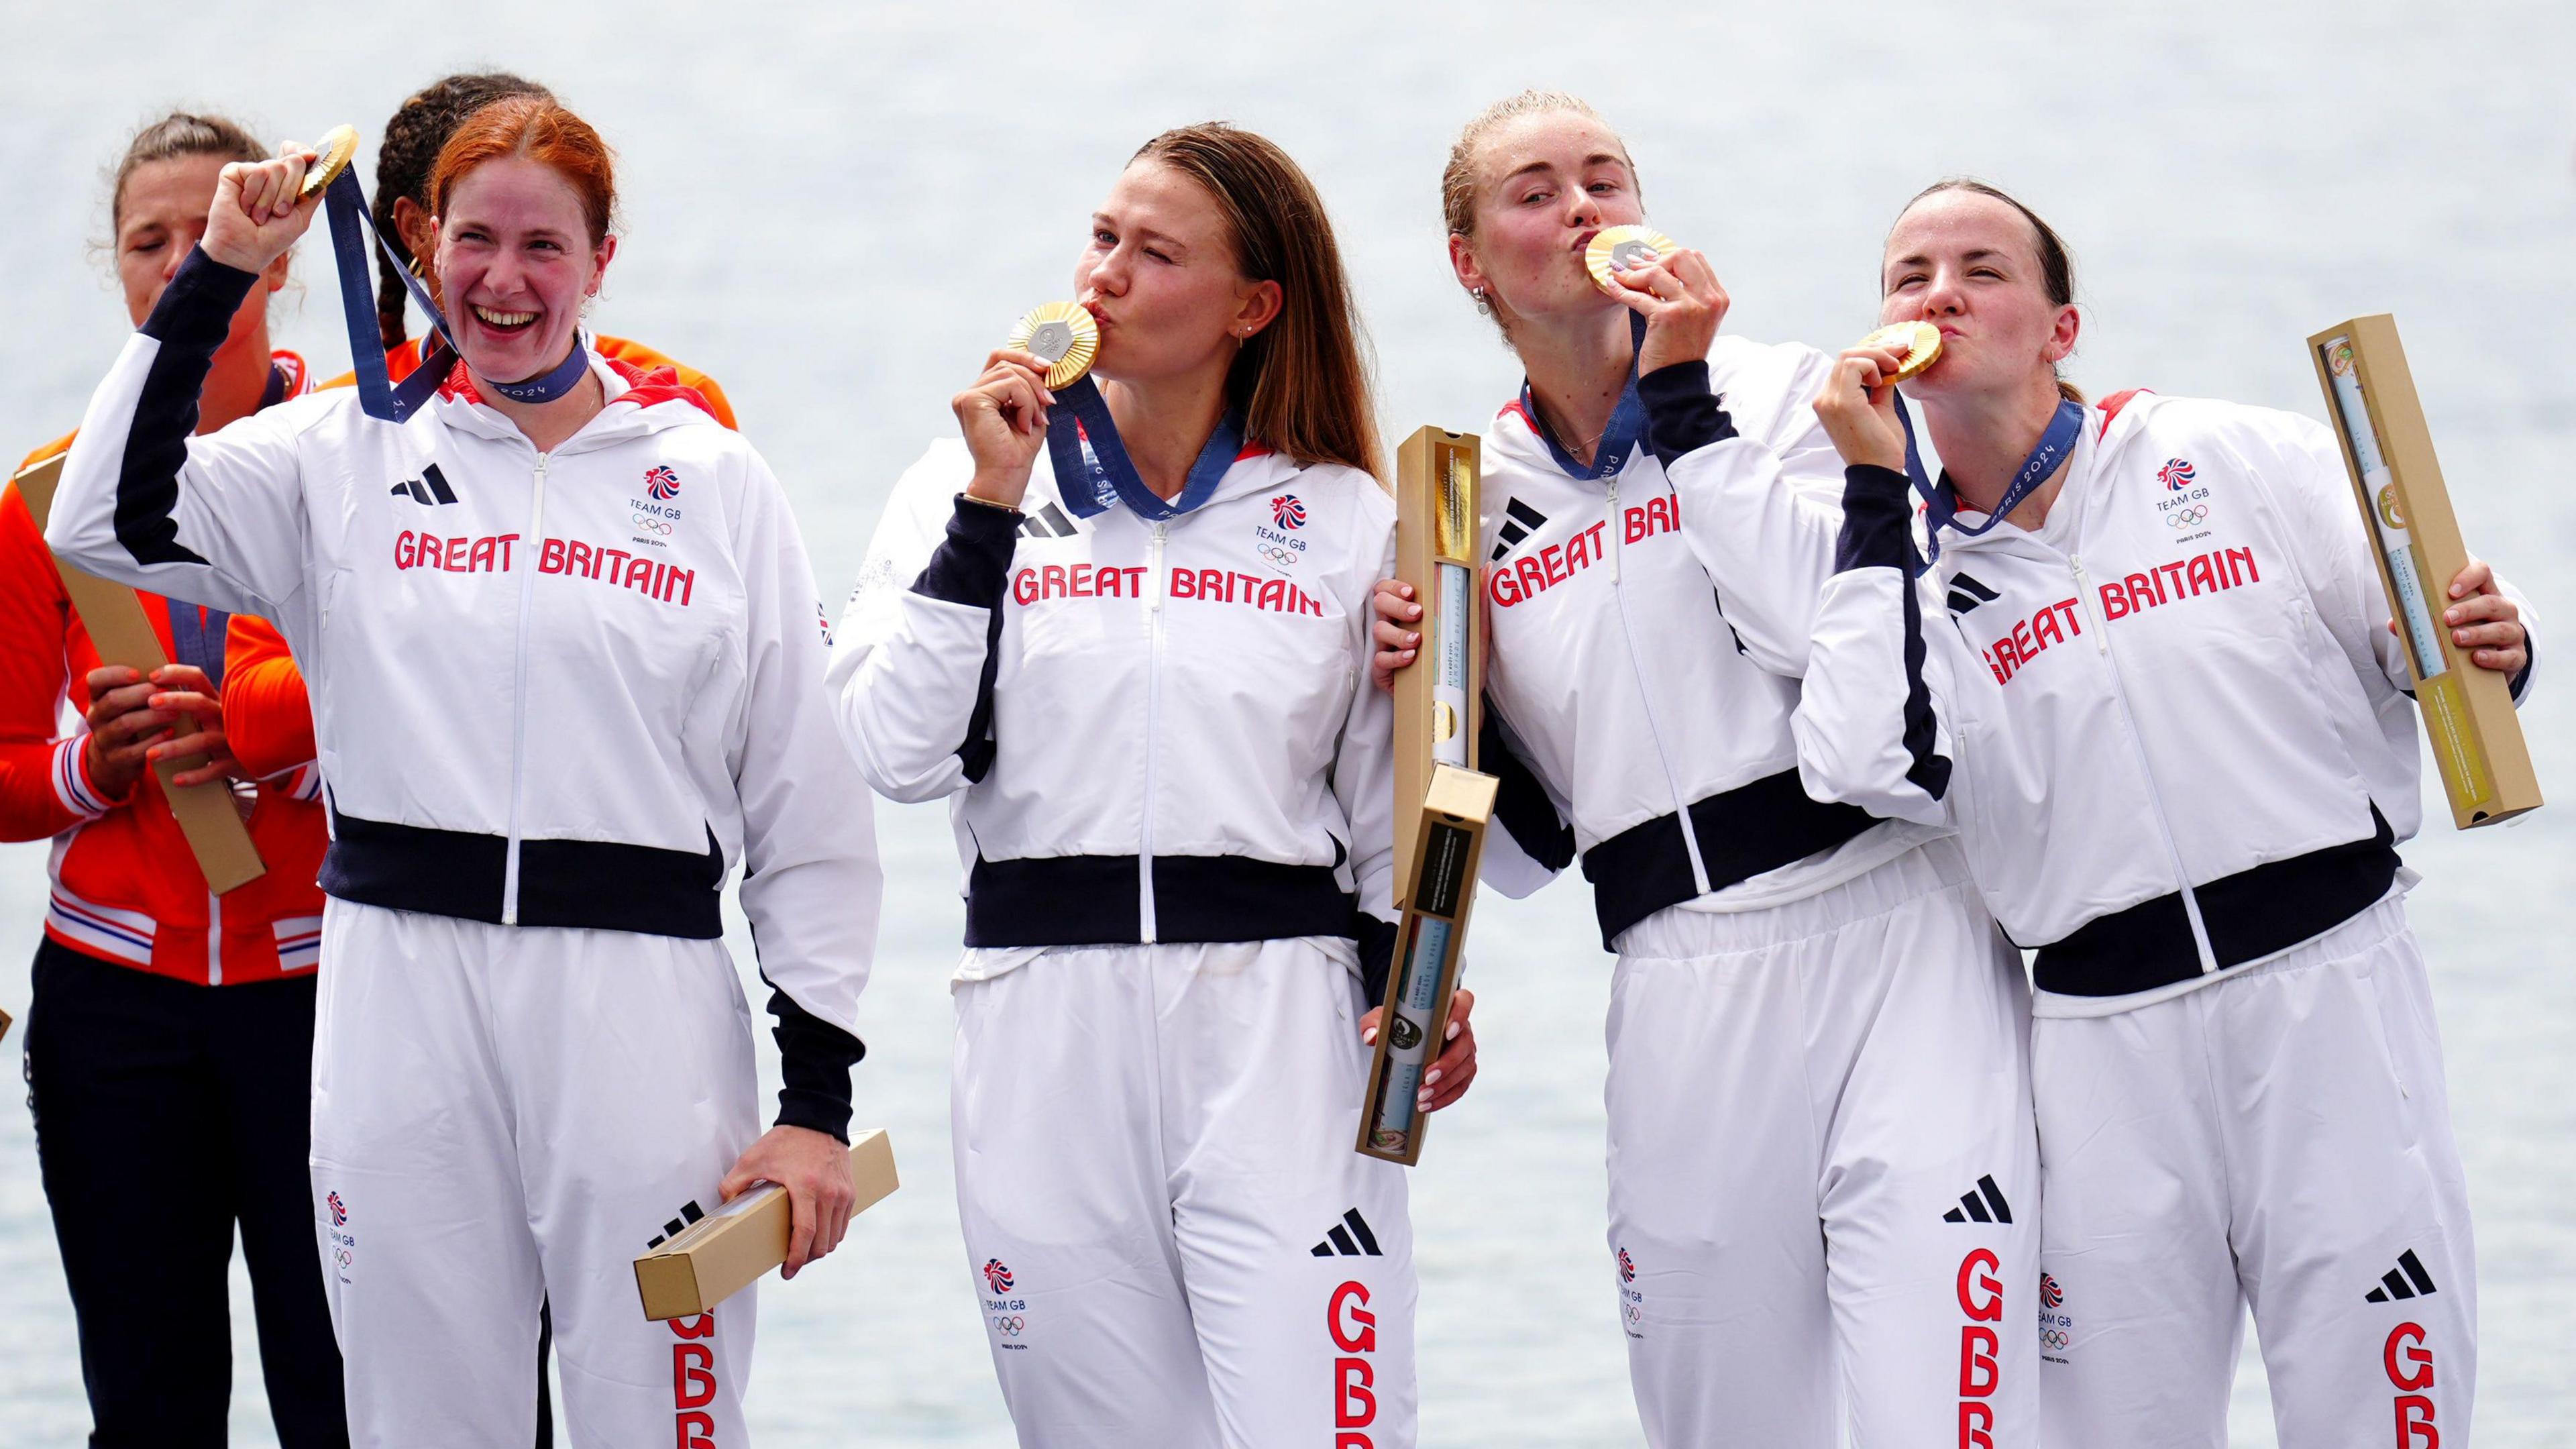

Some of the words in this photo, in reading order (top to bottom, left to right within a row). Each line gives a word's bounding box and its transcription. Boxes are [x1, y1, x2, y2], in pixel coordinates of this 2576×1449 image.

[1991, 482, 2022, 524] PARIS
[2024, 445, 2055, 482] 2024
[630, 498, 661, 516] TEAM
[664, 508, 682, 520] GB
[2156, 494, 2189, 512] TEAM
[2192, 488, 2210, 500] GB
[632, 537, 650, 545] PARIS
[650, 539, 667, 548] 2024
[1256, 525, 1287, 545] TEAM
[1289, 539, 1307, 551] GB
[2176, 535, 2194, 544] PARIS
[2194, 531, 2212, 539] 2024
[1490, 520, 1606, 608] GREAT
[1625, 493, 1680, 545] BRI
[395, 530, 520, 572] GREAT
[539, 538, 695, 606] BRITAIN
[1014, 564, 1148, 606] GREAT
[1170, 568, 1324, 617] BRITAIN
[2099, 547, 2260, 621] BRITAIN
[342, 1235, 355, 1246] GB
[986, 1299, 1007, 1311] TEAM
[1010, 1299, 1026, 1311] GB
[1631, 1291, 1642, 1303] GB
[2057, 1316, 2072, 1327] GB
[1328, 1281, 1377, 1449] GB
